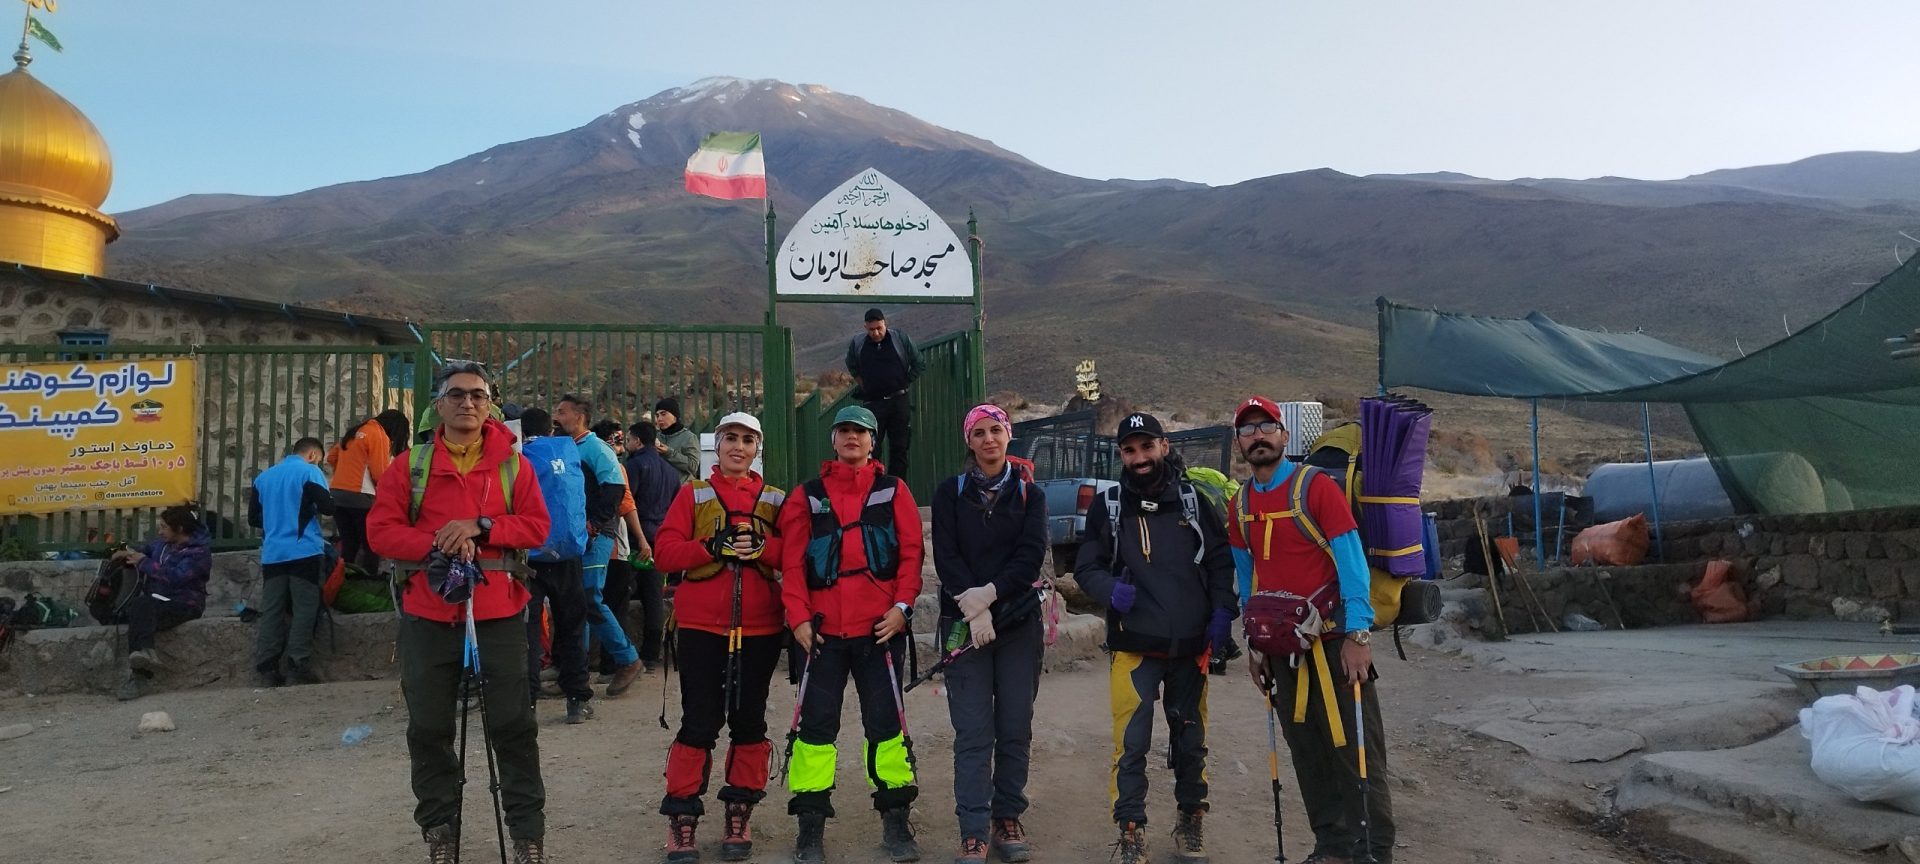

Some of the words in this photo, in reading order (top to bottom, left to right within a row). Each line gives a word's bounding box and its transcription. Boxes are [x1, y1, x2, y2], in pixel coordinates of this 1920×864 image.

[859, 173, 879, 185] الله
[849, 185, 884, 193] بسم
[789, 249, 848, 283] الزمان
[840, 250, 917, 290] صاحب
[913, 243, 955, 289] مسجد
[0, 367, 95, 397] کوهن
[99, 364, 173, 395] لوازم
[70, 443, 114, 457] استور
[120, 441, 174, 454] دماوند
[124, 456, 148, 468] قسط
[168, 460, 174, 470] و
[106, 490, 163, 499] damavandstore
